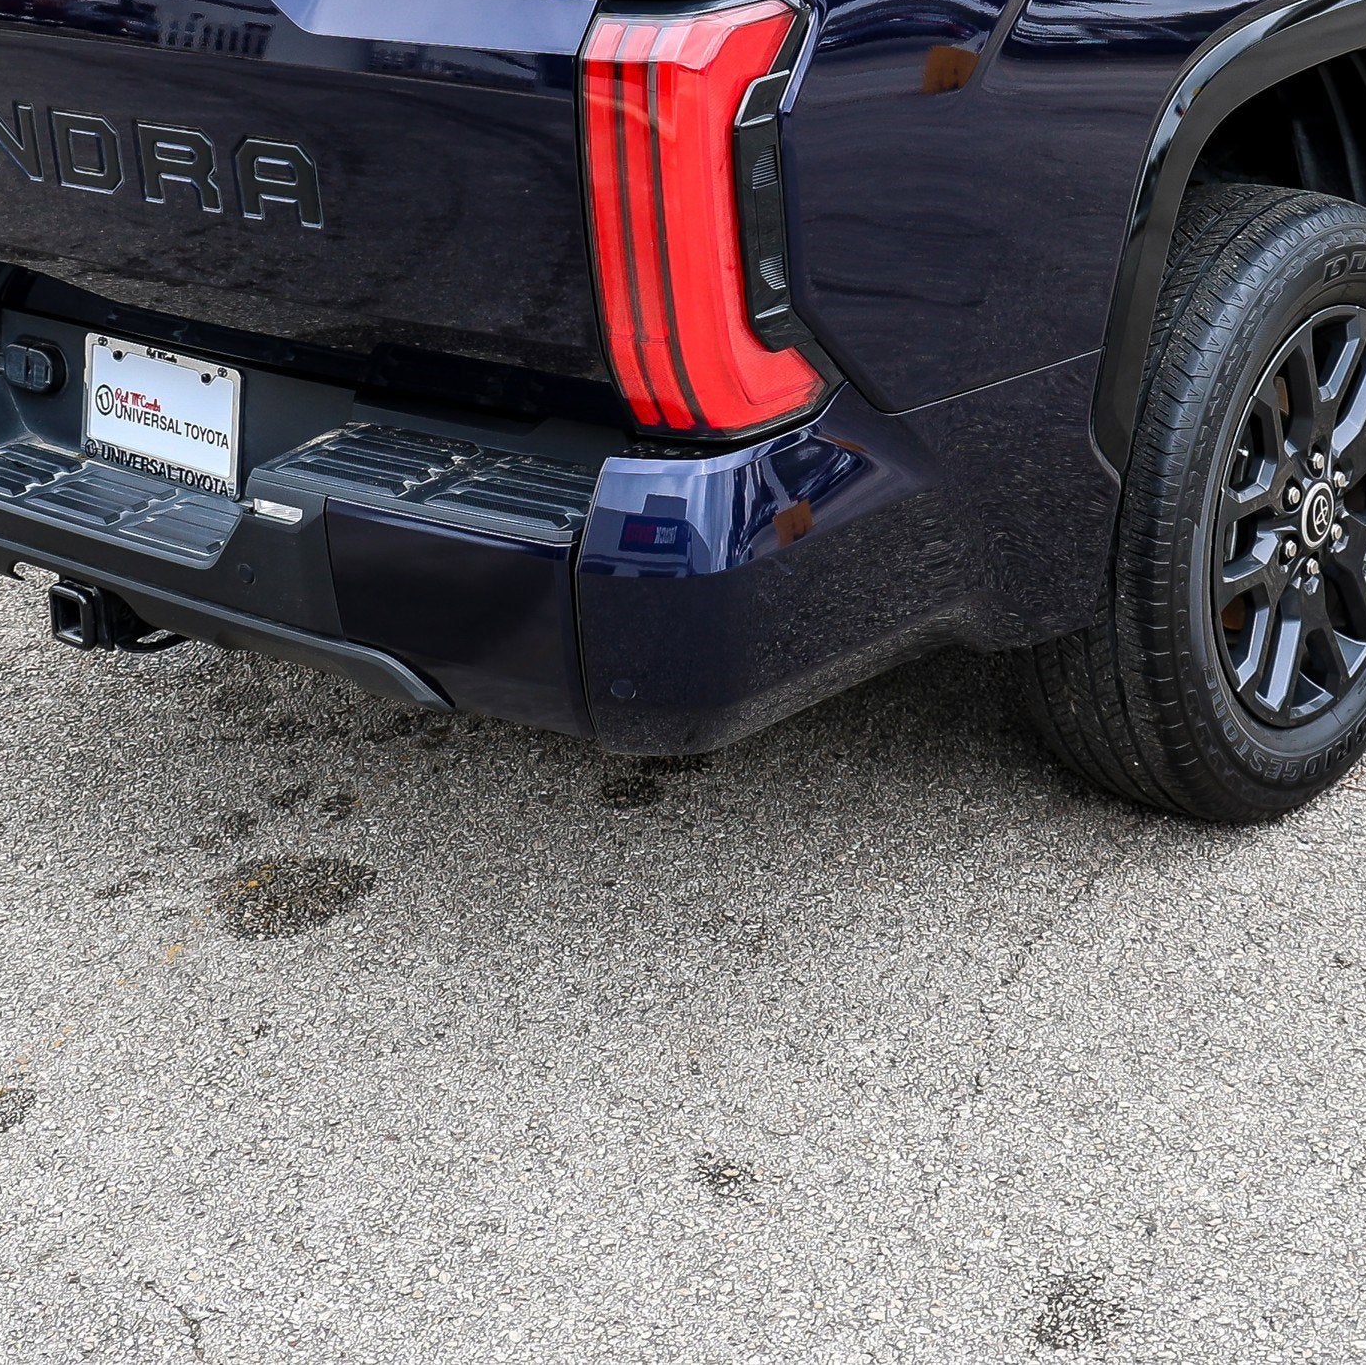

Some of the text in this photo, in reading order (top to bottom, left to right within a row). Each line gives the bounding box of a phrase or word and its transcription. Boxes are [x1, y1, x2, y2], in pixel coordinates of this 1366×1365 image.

[115, 403, 229, 449] UNIVERSAL TOYOTA
[102, 444, 229, 498] UNIVERSAL TOYOTA
